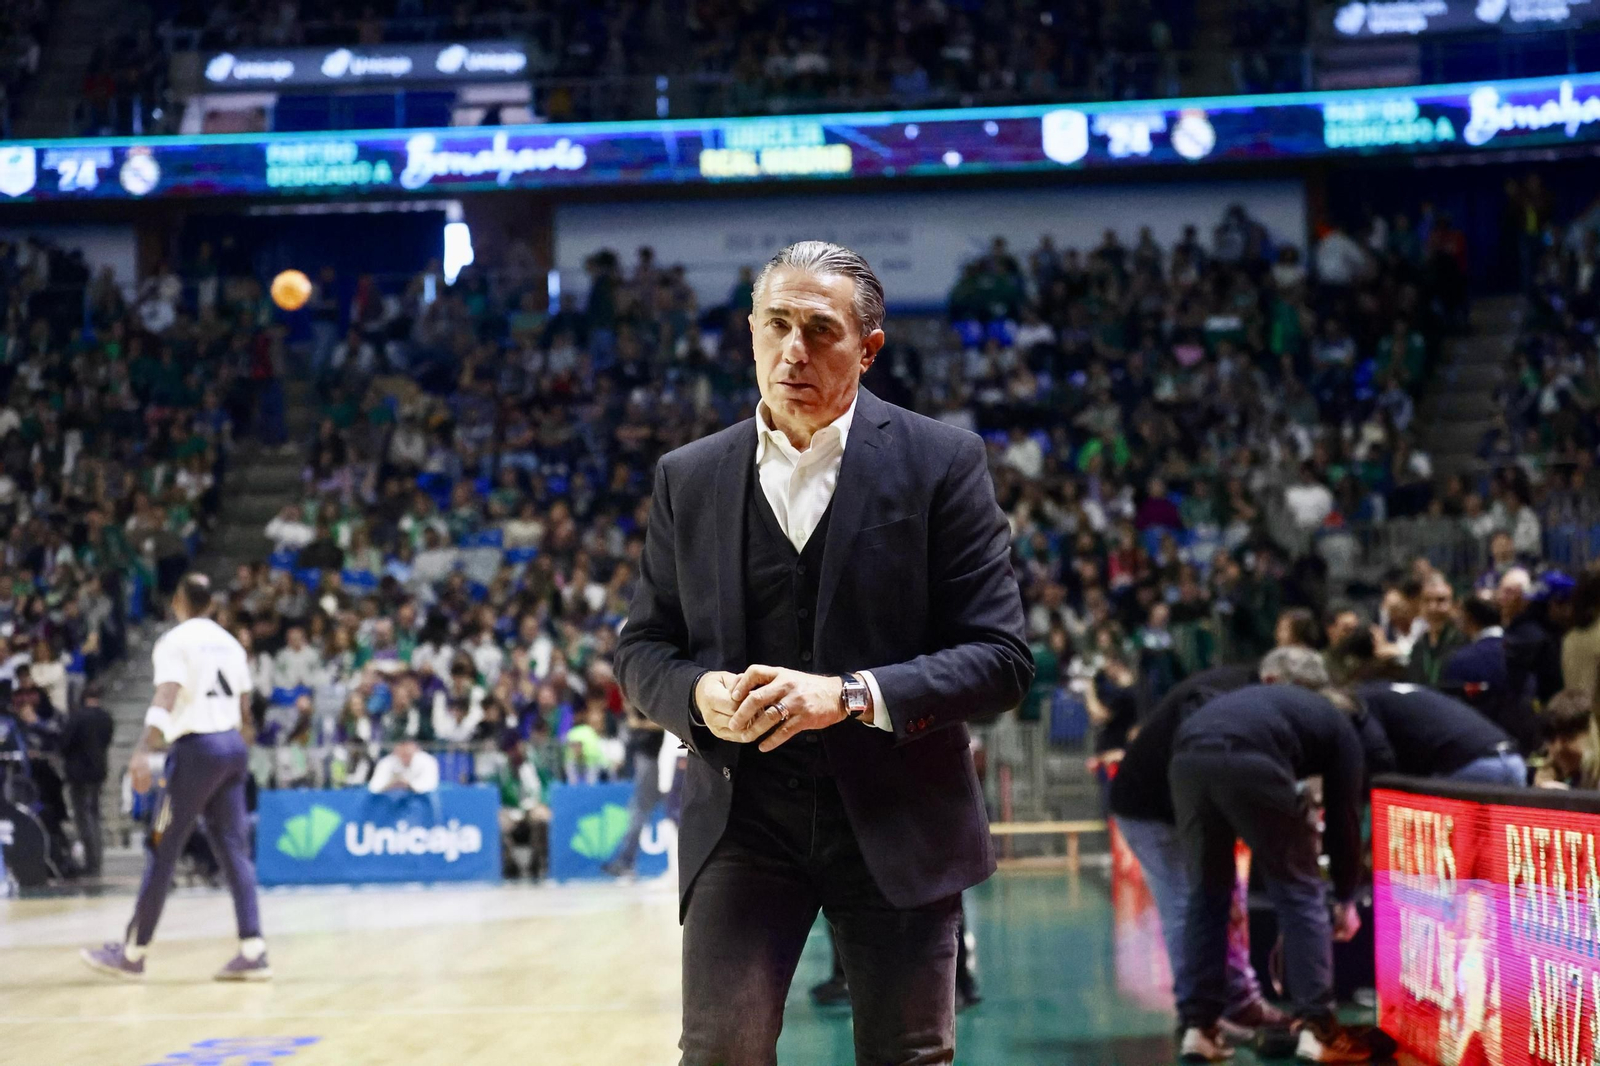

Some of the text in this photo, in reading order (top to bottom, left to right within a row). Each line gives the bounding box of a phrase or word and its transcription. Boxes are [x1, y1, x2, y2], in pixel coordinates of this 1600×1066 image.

[1435, 116, 1456, 142] A
[57, 158, 99, 192] 24
[265, 160, 392, 187] DEDICADO A
[344, 819, 483, 863] Unicaja
